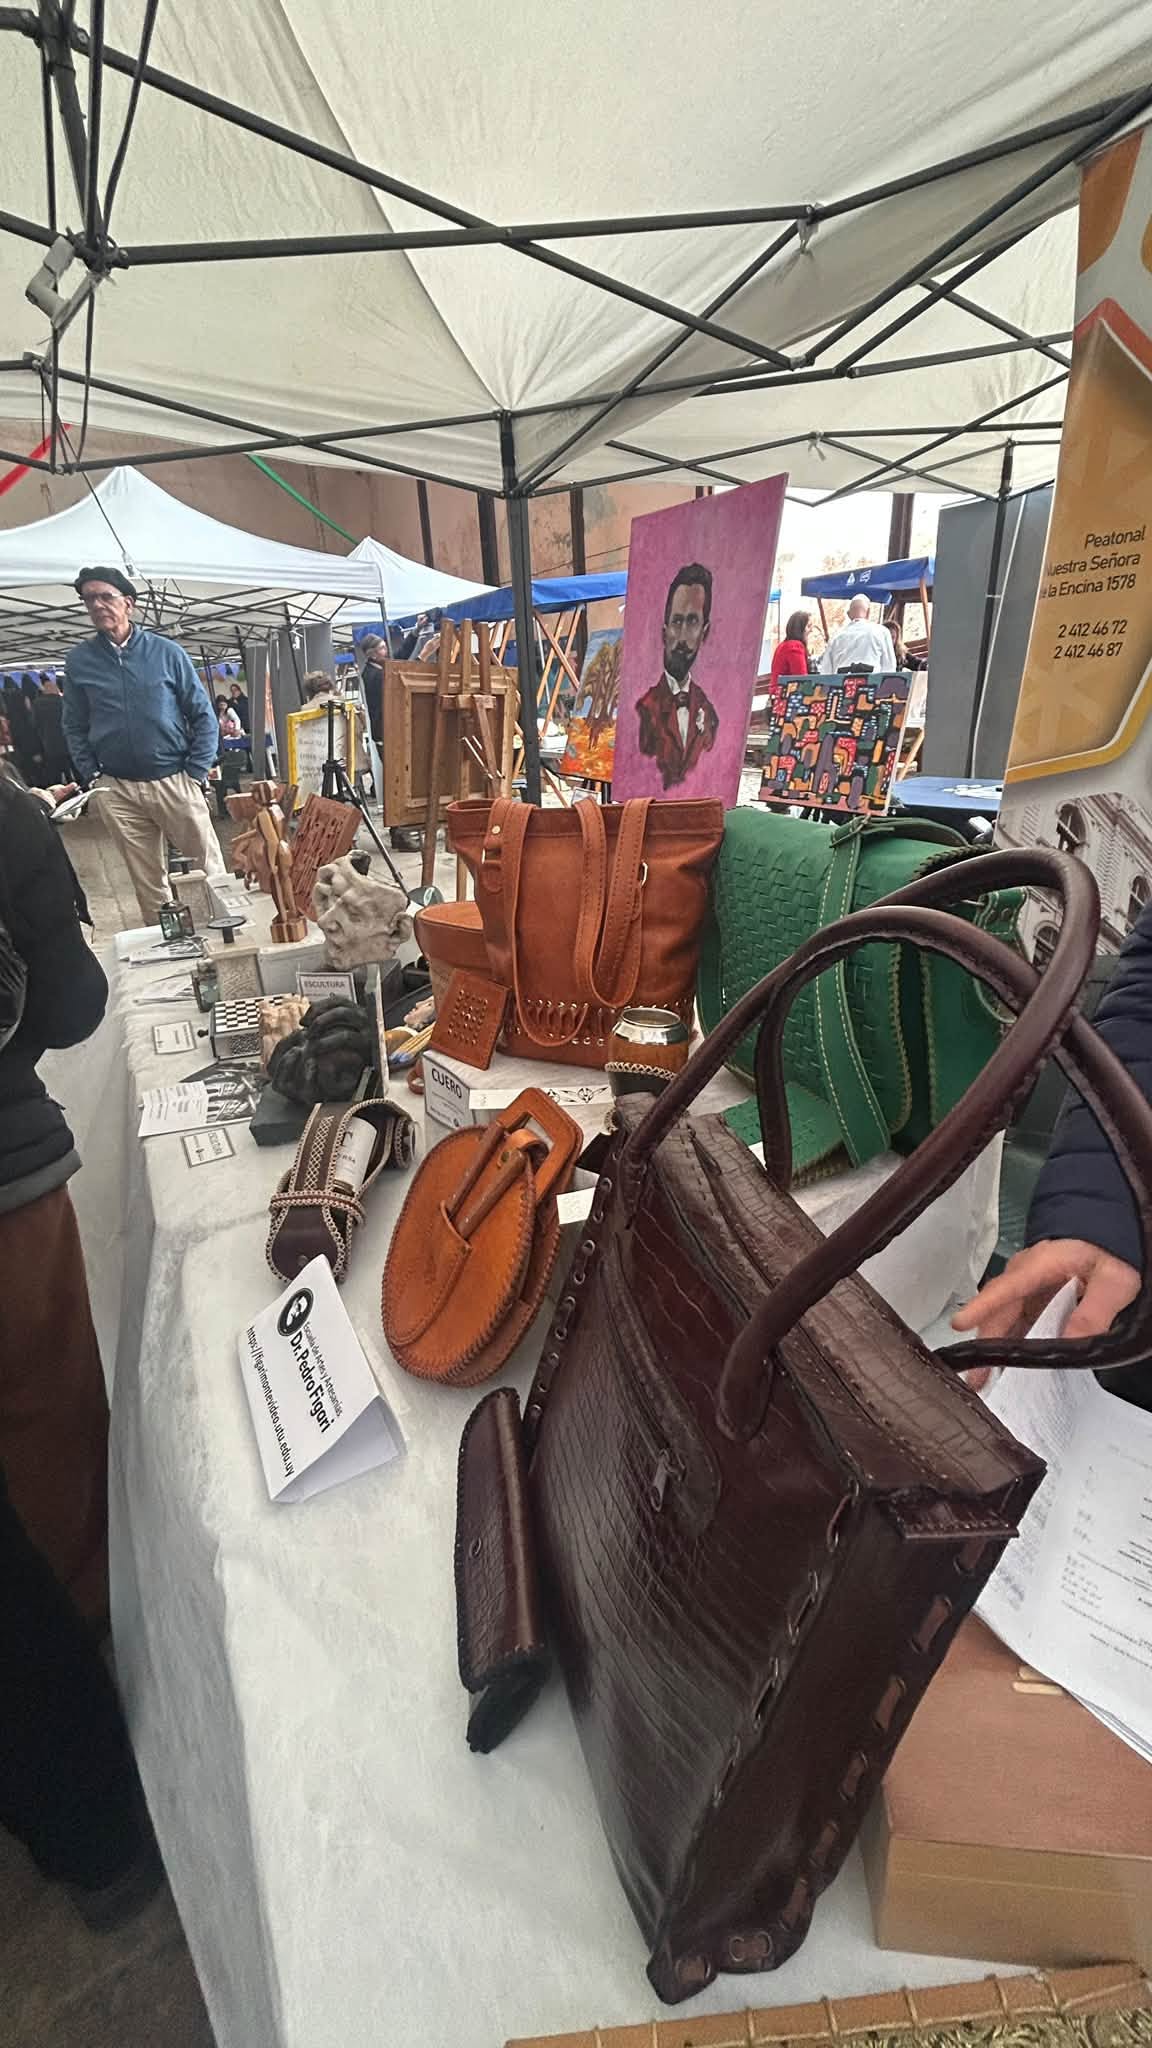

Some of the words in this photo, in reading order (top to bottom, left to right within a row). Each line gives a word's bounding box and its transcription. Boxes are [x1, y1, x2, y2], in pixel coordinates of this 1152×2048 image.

[1084, 525, 1146, 549] Peatonal
[1089, 552, 1141, 571] Señora
[1059, 579, 1104, 596] Encina
[1106, 573, 1136, 591] 1578
[1058, 624, 1067, 638] 2
[1068, 622, 1090, 637] 412
[1092, 620, 1109, 636] 46
[1112, 619, 1128, 634] 72
[1053, 645, 1063, 659] 2
[1064, 644, 1086, 658] 412
[1087, 643, 1104, 657] 46
[1106, 641, 1123, 657] 87
[431, 1067, 462, 1099] CUERO
[290, 1331, 302, 1356] Dr.
[297, 1348, 316, 1391] Pedro
[309, 1384, 335, 1433] Figari
[246, 1325, 295, 1478] https://figarimontevideo.utu.edu.uy
